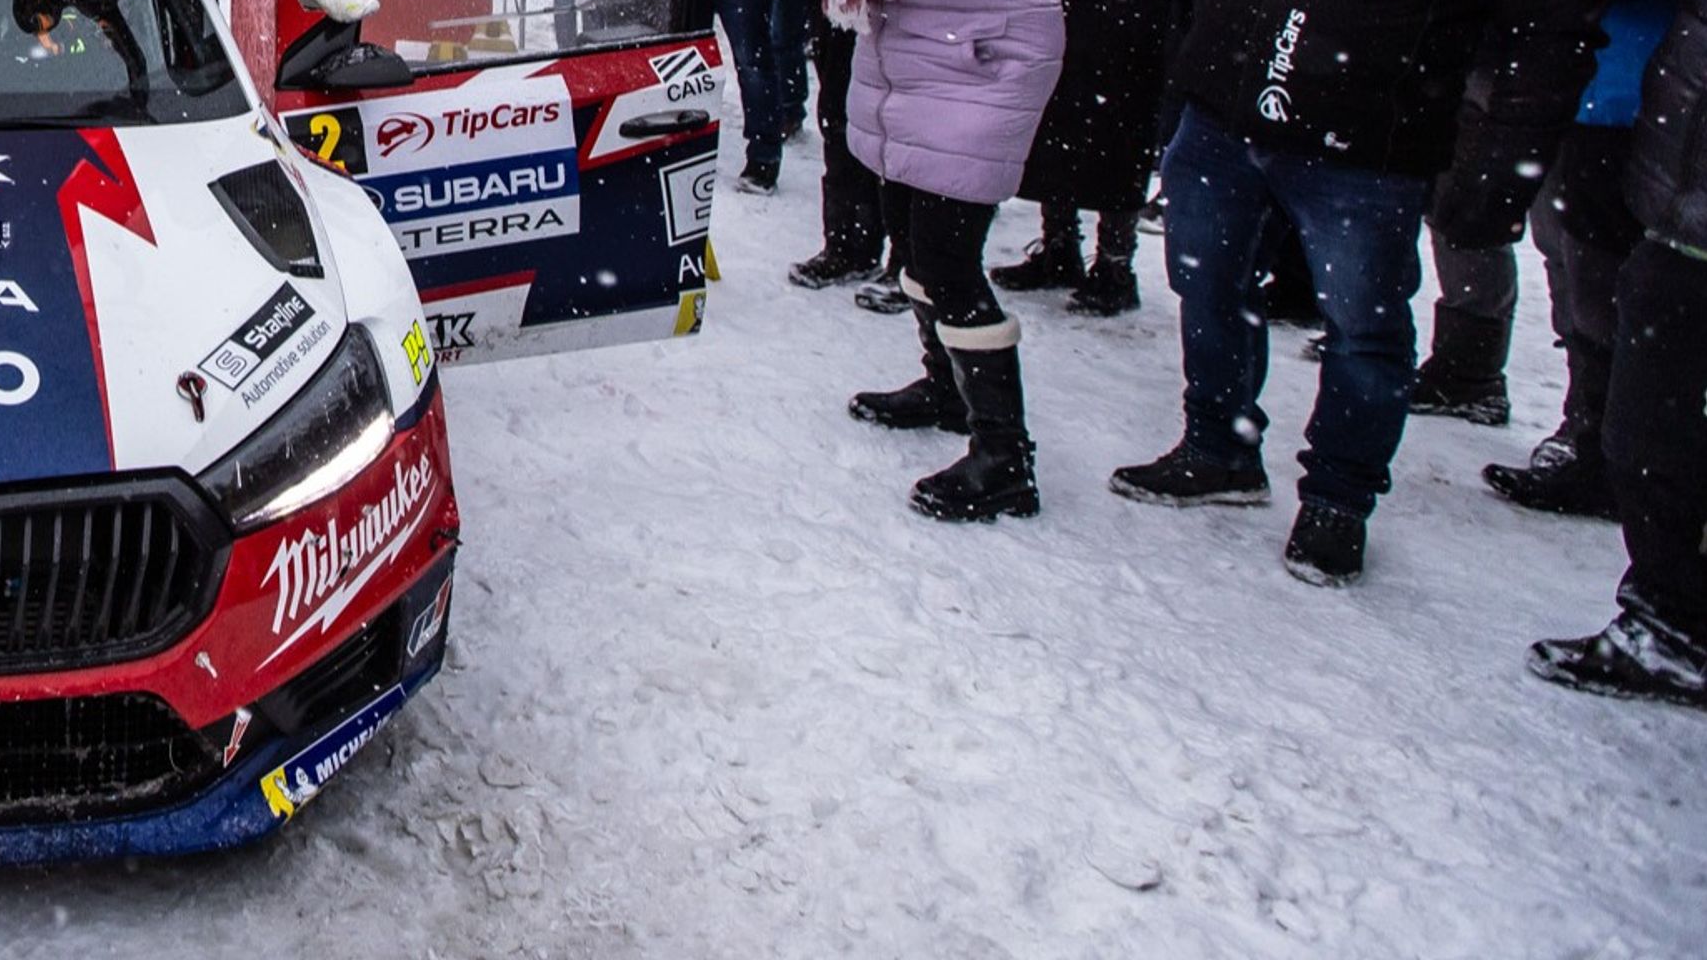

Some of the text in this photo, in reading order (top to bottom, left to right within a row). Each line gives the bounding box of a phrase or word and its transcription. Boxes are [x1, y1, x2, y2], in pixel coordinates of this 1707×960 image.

[1267, 8, 1306, 82] TipCars
[667, 74, 716, 103] CAIS
[309, 113, 345, 171] 2
[441, 102, 561, 139] TipCars
[395, 163, 565, 213] SUBARU
[246, 294, 306, 351] Starline
[241, 320, 331, 409] Automotive solution
[260, 451, 434, 635] Milwaukee
